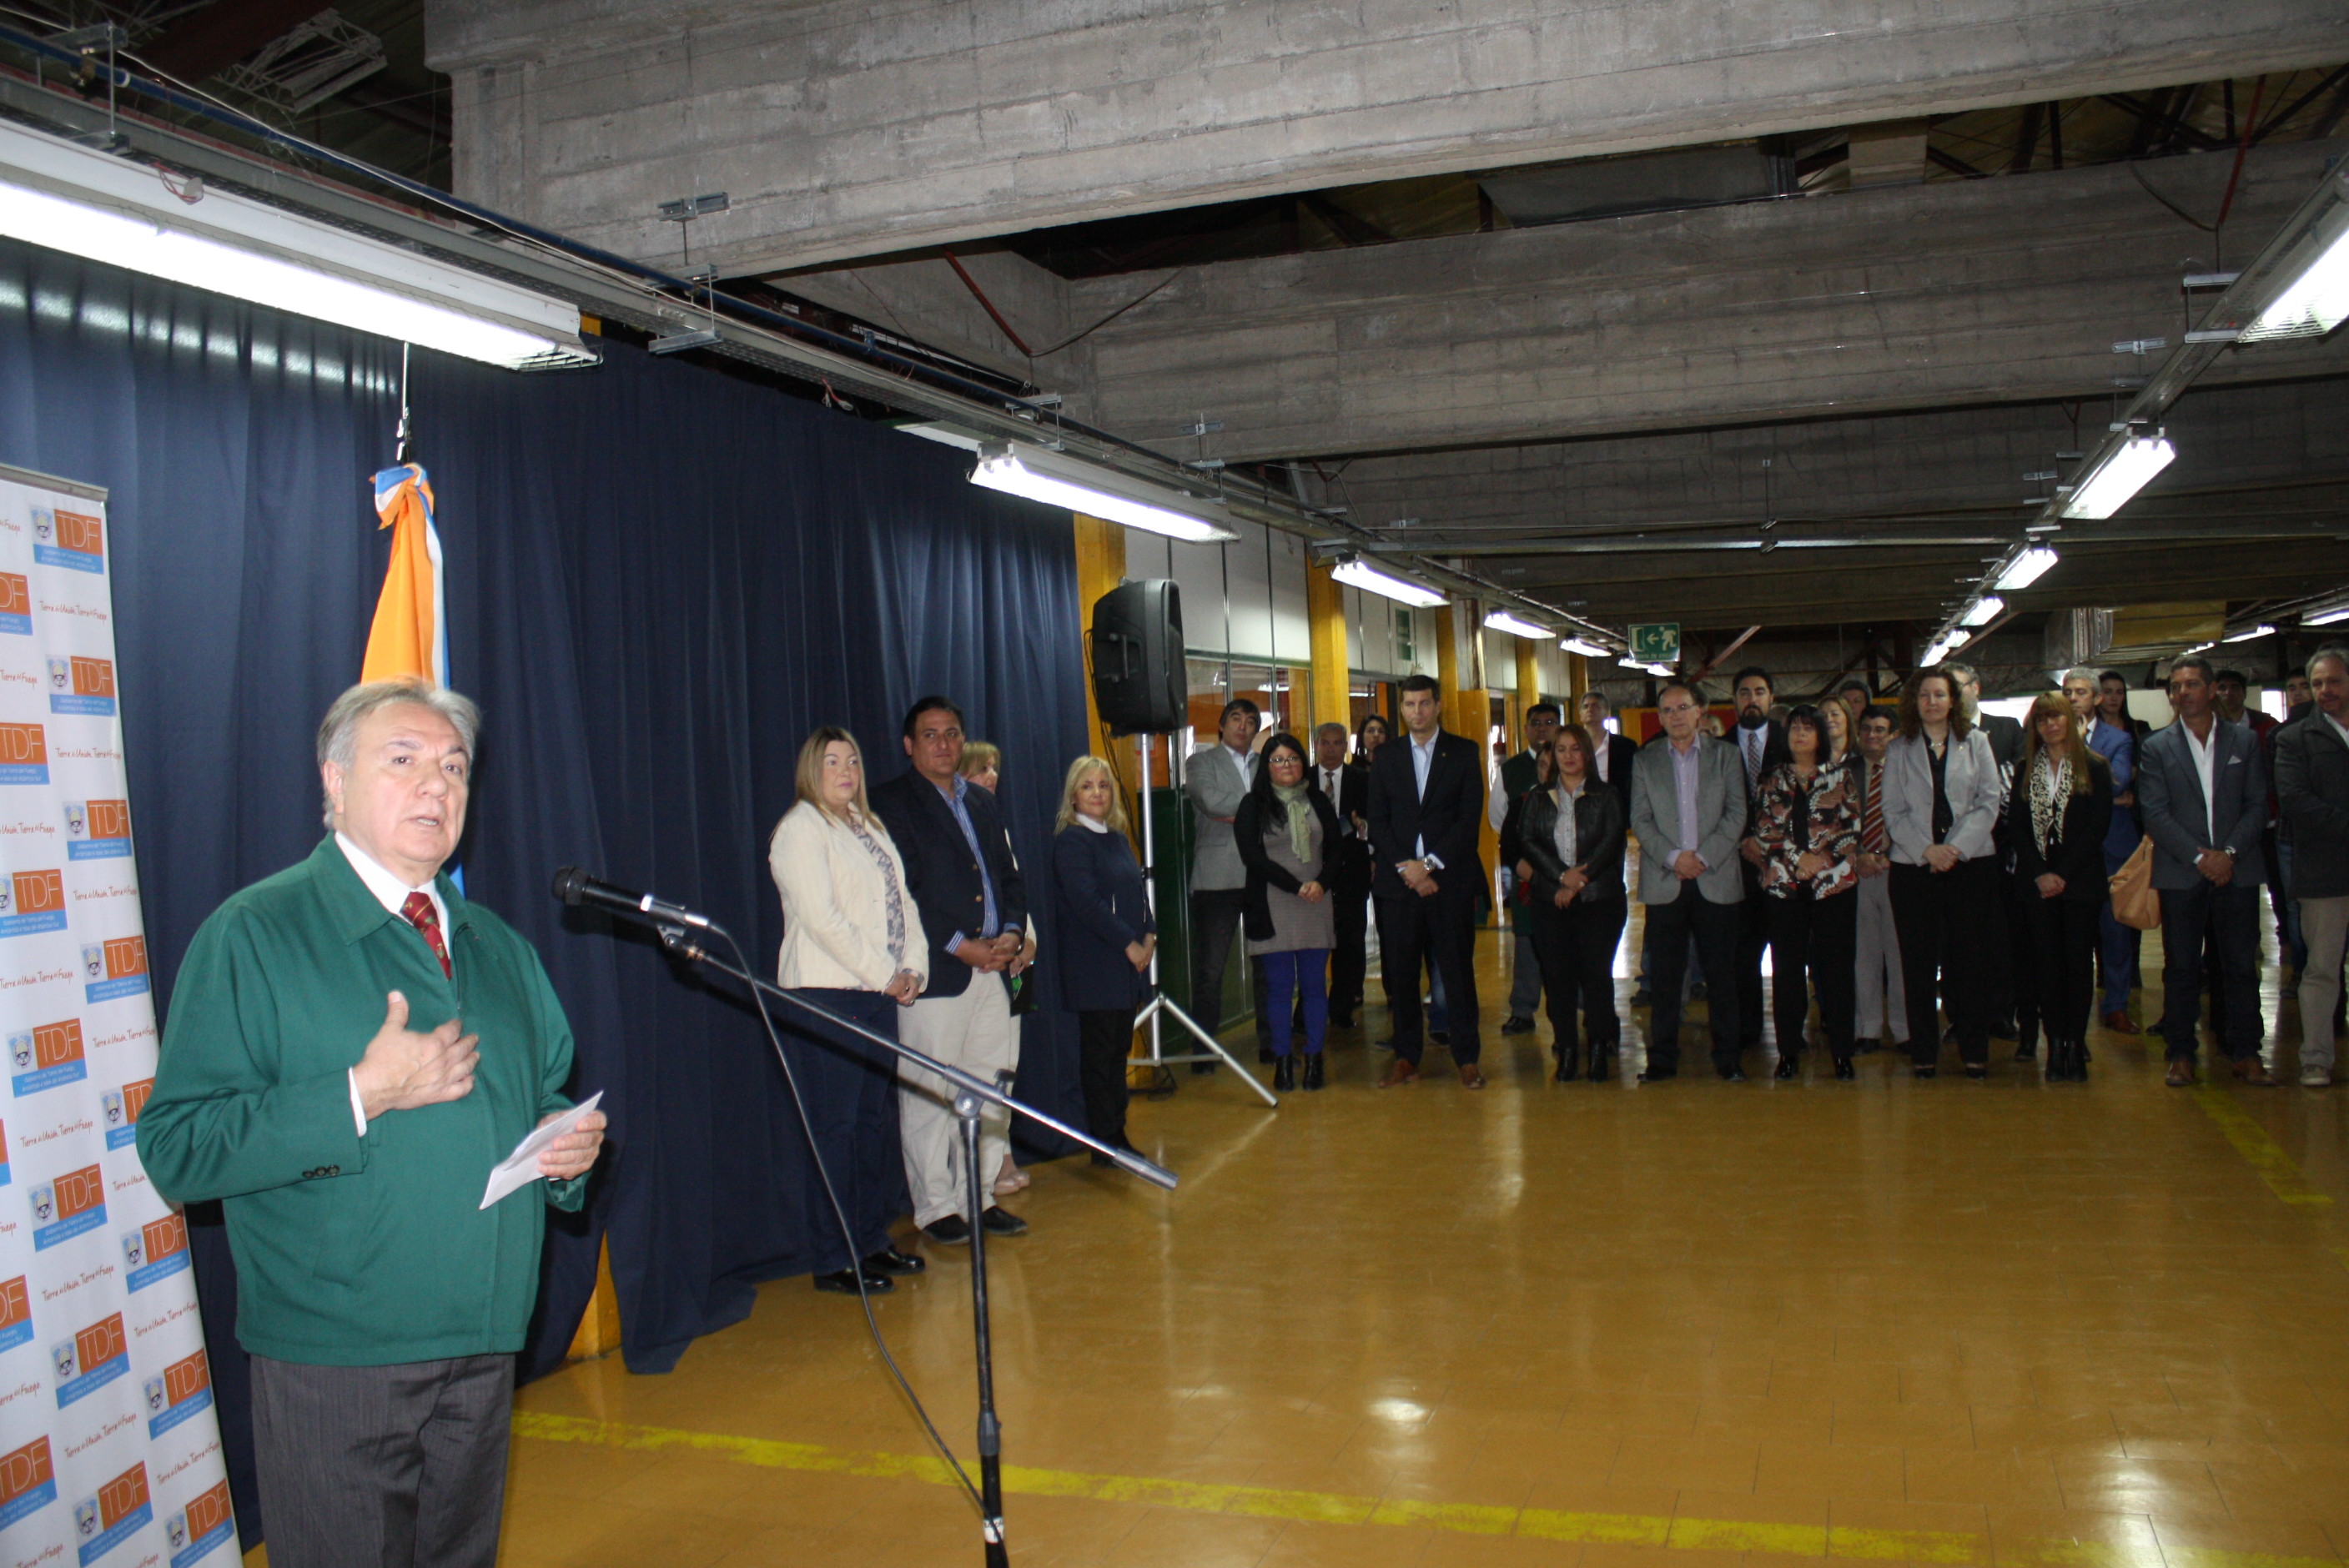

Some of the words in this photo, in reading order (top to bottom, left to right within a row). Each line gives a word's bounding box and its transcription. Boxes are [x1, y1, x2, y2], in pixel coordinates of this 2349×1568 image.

[56, 514, 98, 549] TDF
[0, 575, 24, 609] DF
[73, 661, 110, 691] TDF
[0, 727, 42, 760] TDF
[88, 804, 125, 835] TDF
[15, 873, 59, 908] TDF
[105, 940, 143, 974] TDF
[35, 1023, 78, 1063] TDF
[125, 1083, 153, 1117] TD
[56, 1168, 99, 1212] TDF
[145, 1215, 186, 1257] TDF
[78, 1316, 120, 1366] TDF
[166, 1353, 205, 1399] TDF
[102, 1466, 143, 1520] TDF
[189, 1485, 227, 1533] TDF
